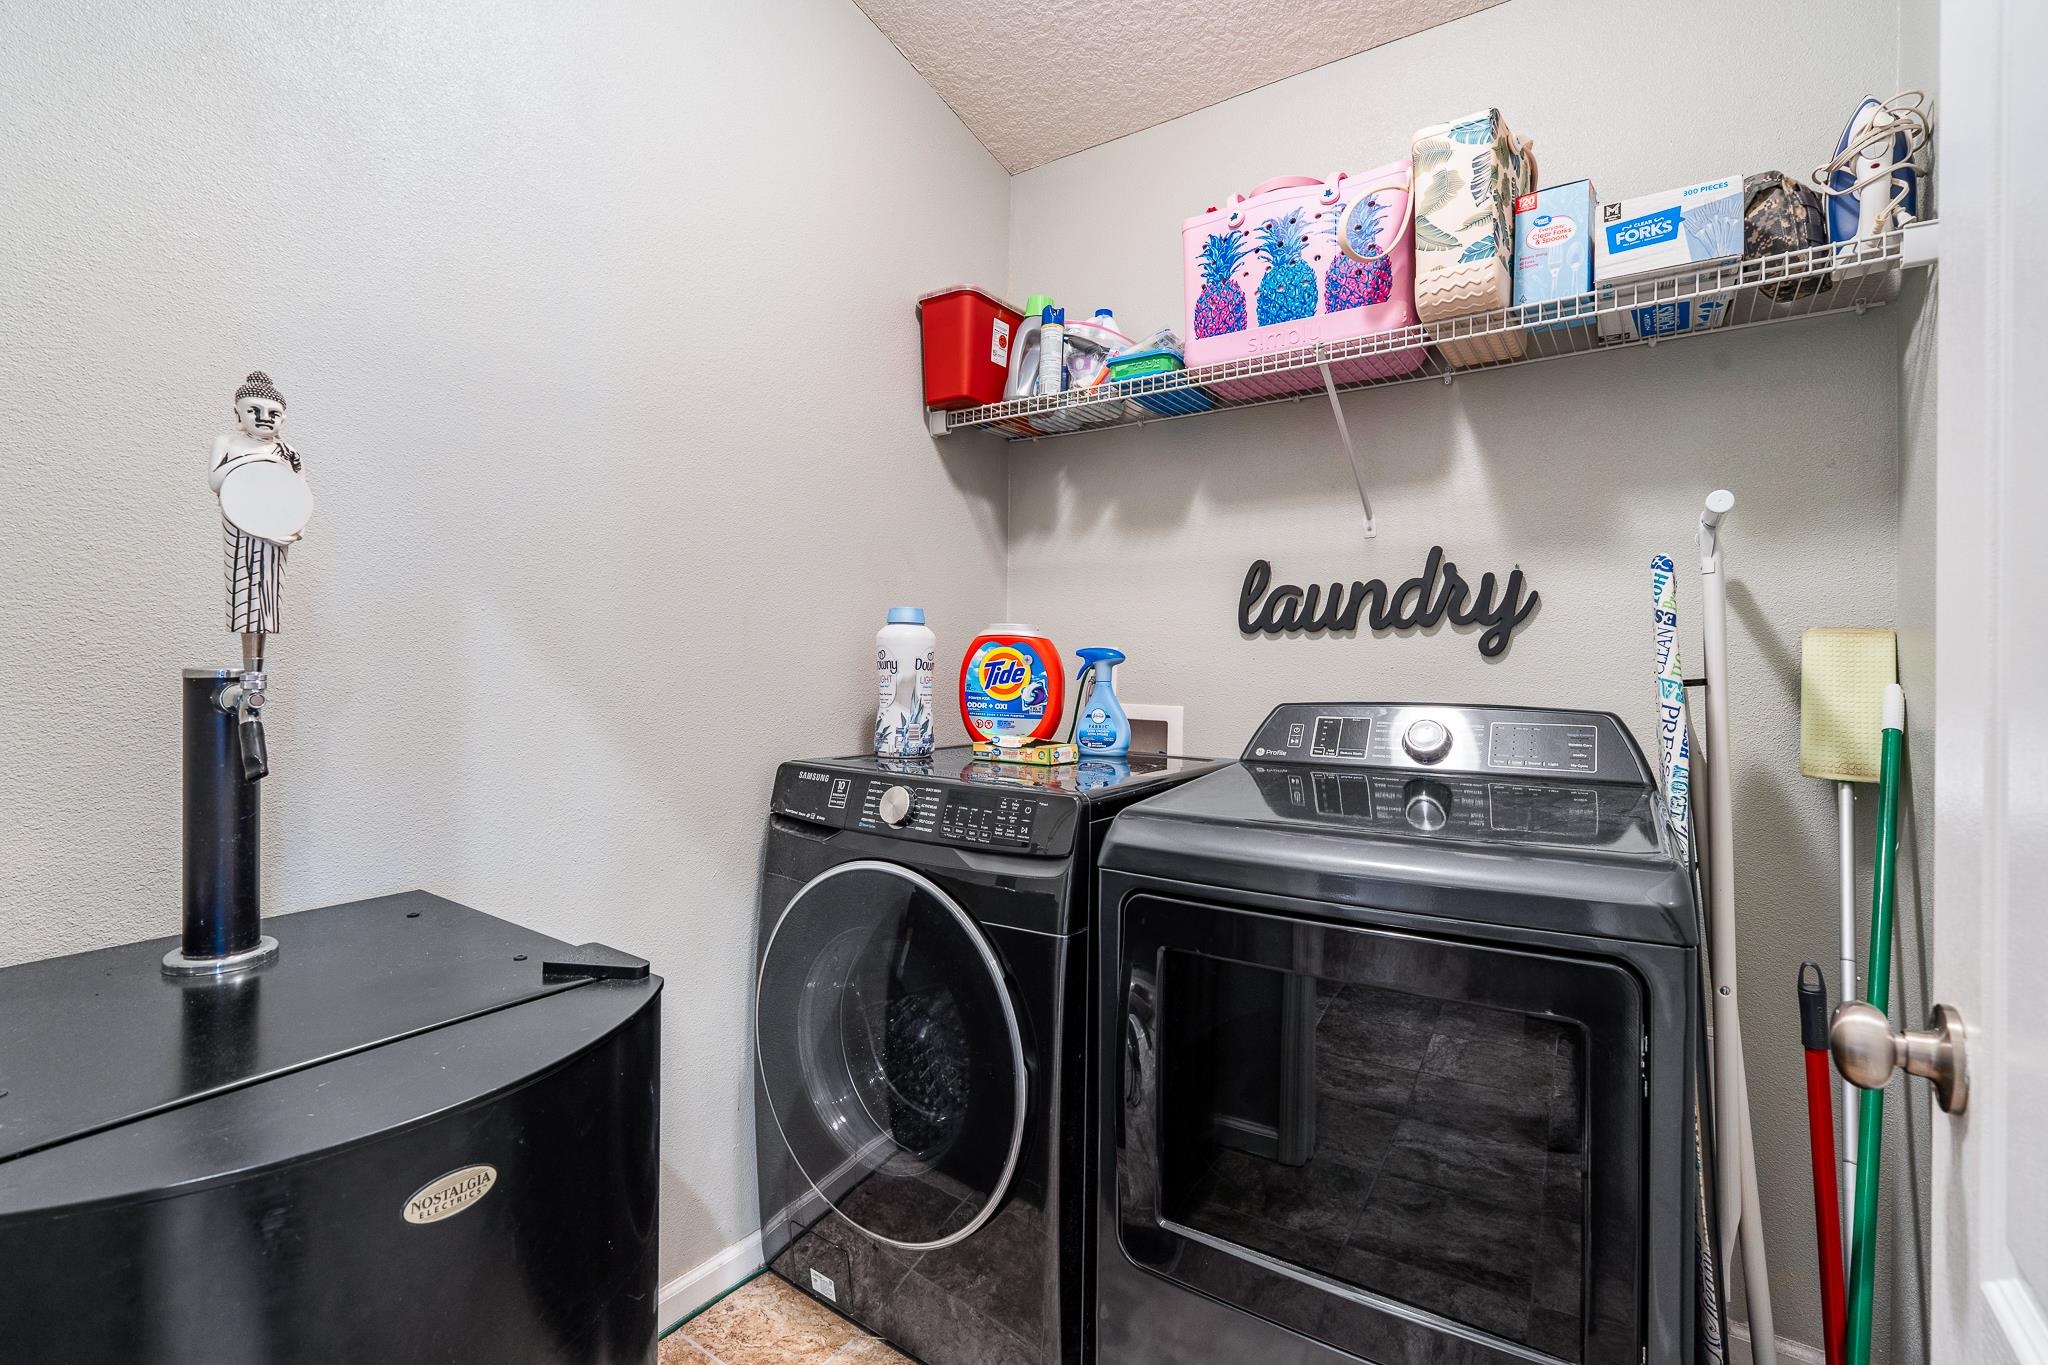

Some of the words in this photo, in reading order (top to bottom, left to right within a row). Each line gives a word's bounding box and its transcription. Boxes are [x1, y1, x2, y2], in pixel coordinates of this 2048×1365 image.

[1683, 188, 1699, 197] 300
[1700, 181, 1729, 193] PIECES
[1532, 231, 1552, 240] Clear
[1553, 227, 1572, 236] Forks
[1542, 234, 1569, 244] Spoons
[1615, 219, 1673, 246] FORKS
[1238, 545, 1539, 657] laundry
[984, 660, 1026, 690] Tide
[966, 702, 988, 710] ODOR
[1265, 749, 1287, 757] Profile
[798, 770, 830, 783] SAMSUNG
[837, 780, 846, 790] 10
[411, 1172, 491, 1215] NOSTALGIA
[419, 1186, 482, 1219] ELECTRICS
